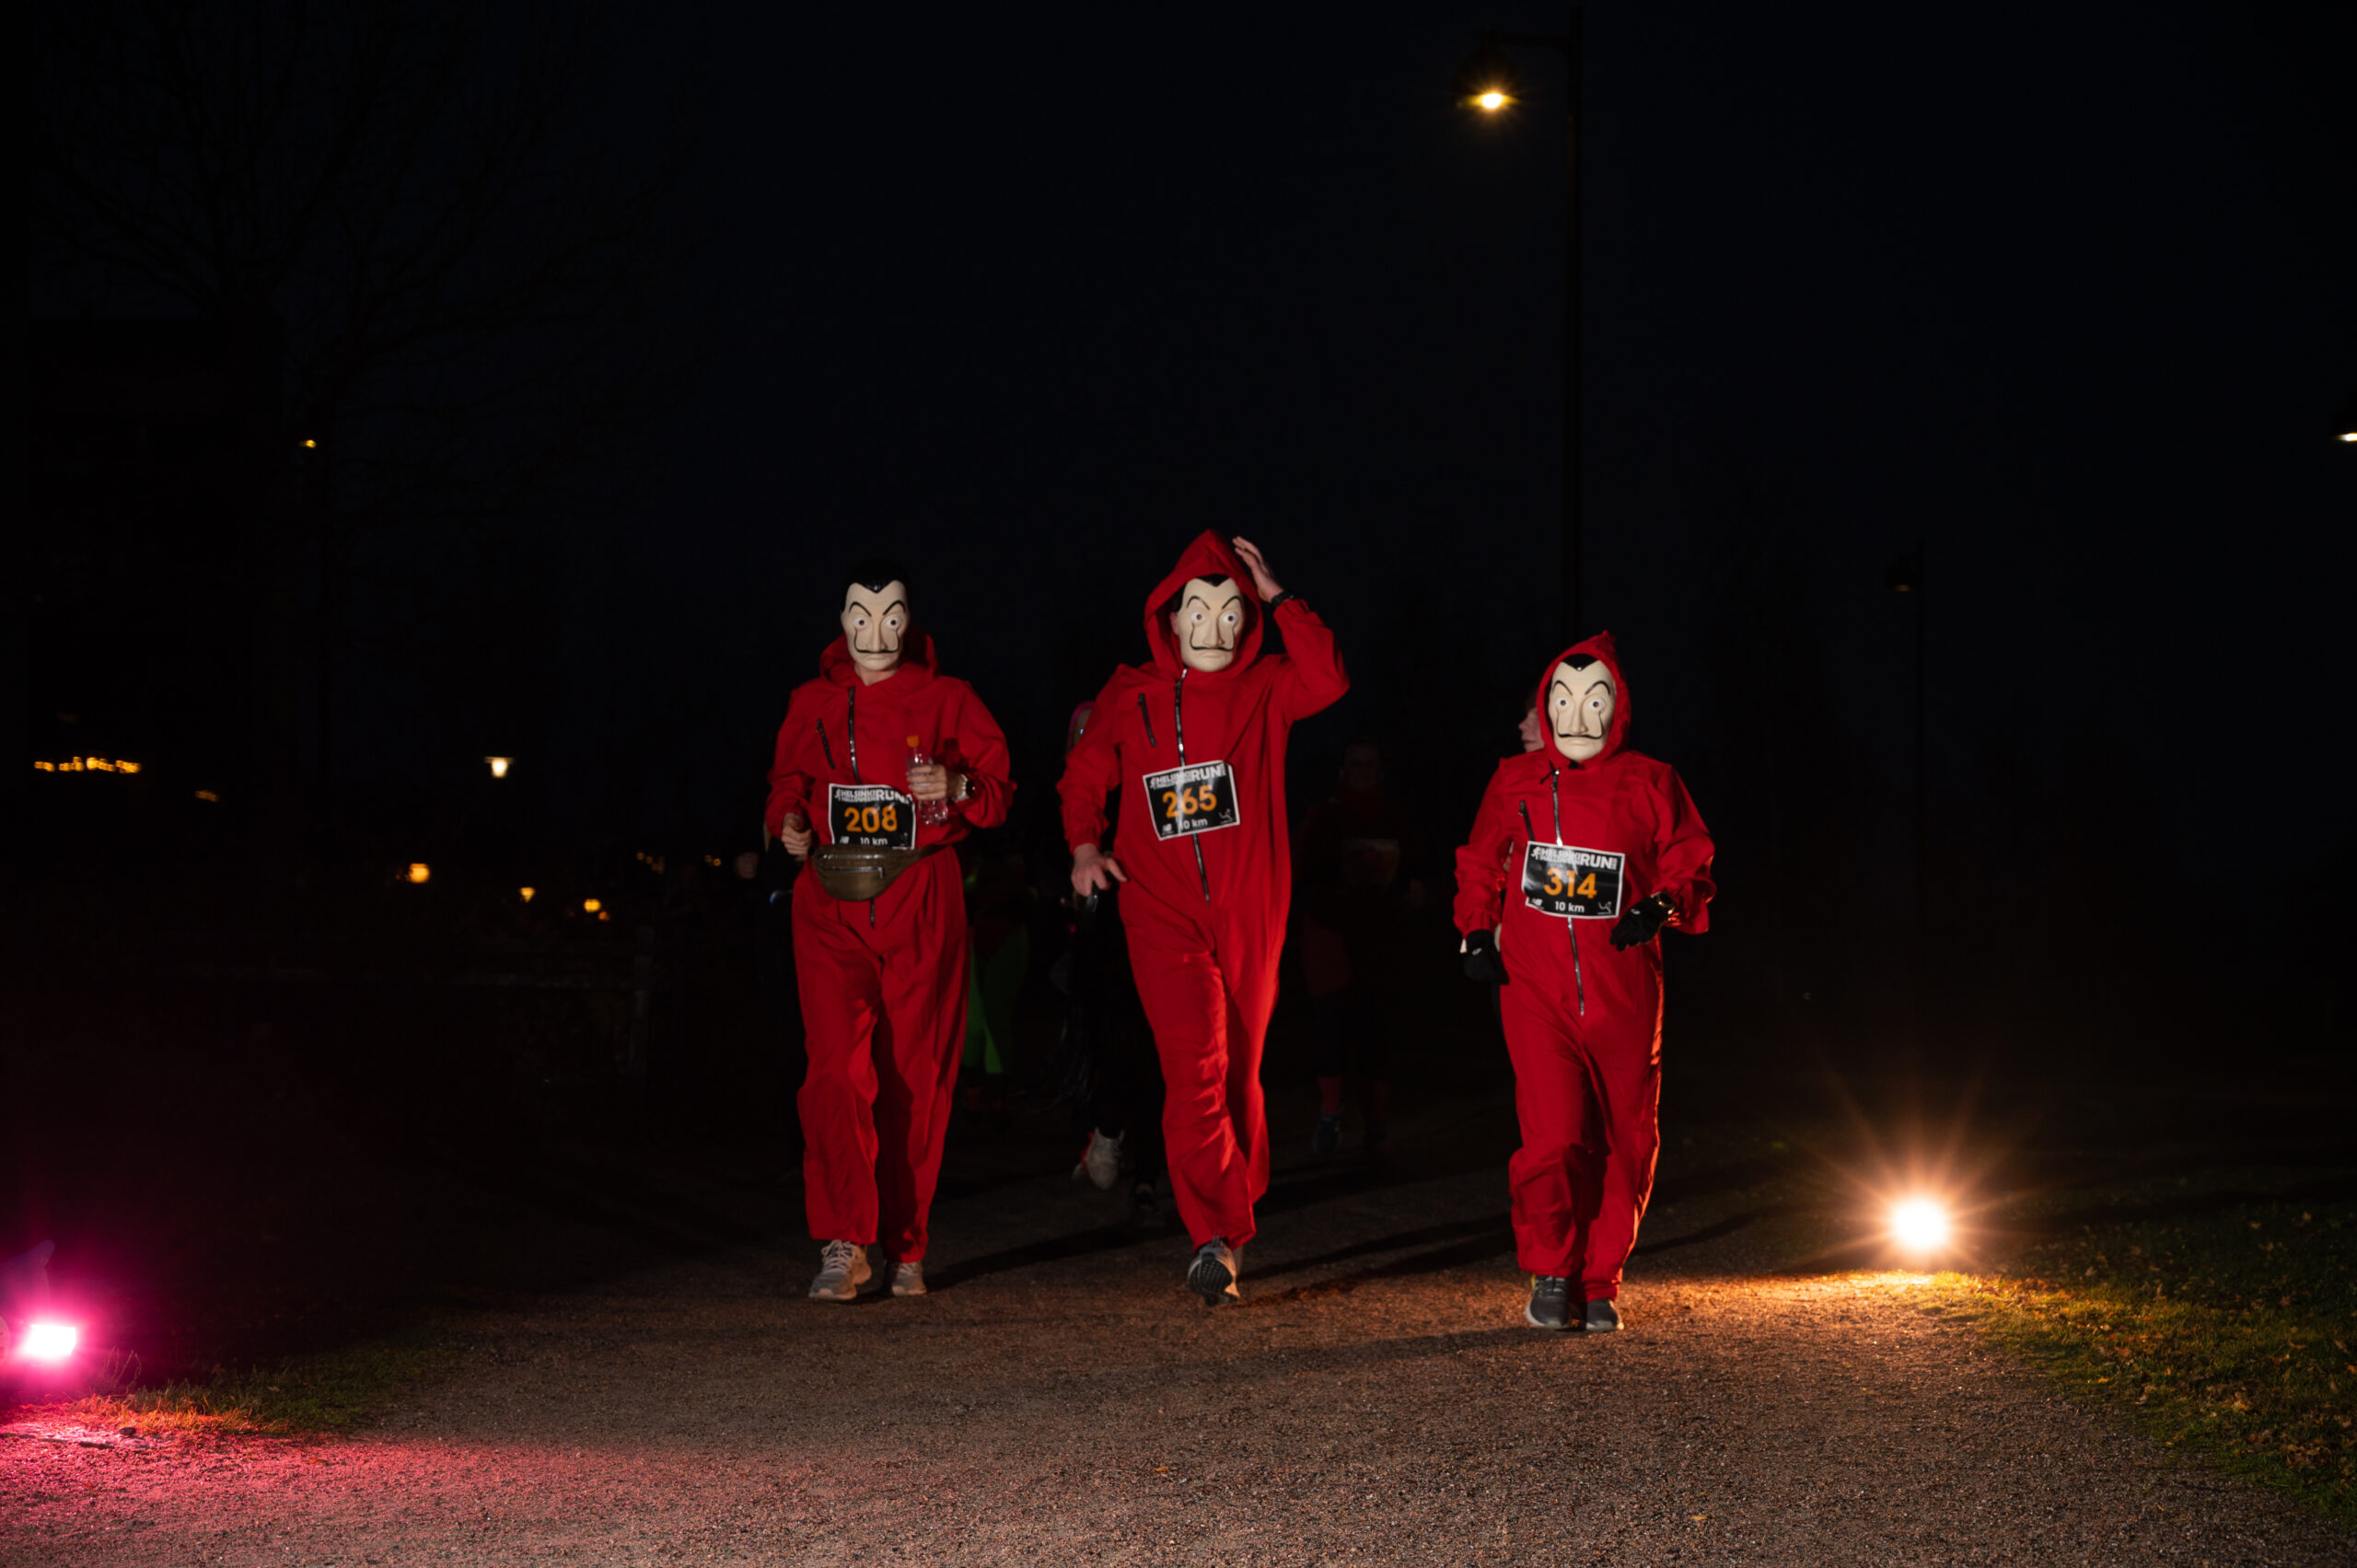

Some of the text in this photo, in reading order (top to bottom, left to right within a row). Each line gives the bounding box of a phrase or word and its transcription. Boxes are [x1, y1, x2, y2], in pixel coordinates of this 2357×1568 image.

[1190, 765, 1221, 782] RUN
[1161, 783, 1218, 818] 265
[843, 805, 899, 833] 208
[1191, 817, 1208, 829] km
[872, 836, 888, 845] km
[1580, 854, 1613, 870] RUN
[1543, 866, 1598, 900] 314
[1554, 900, 1566, 912] 10
[1568, 902, 1585, 913] km
